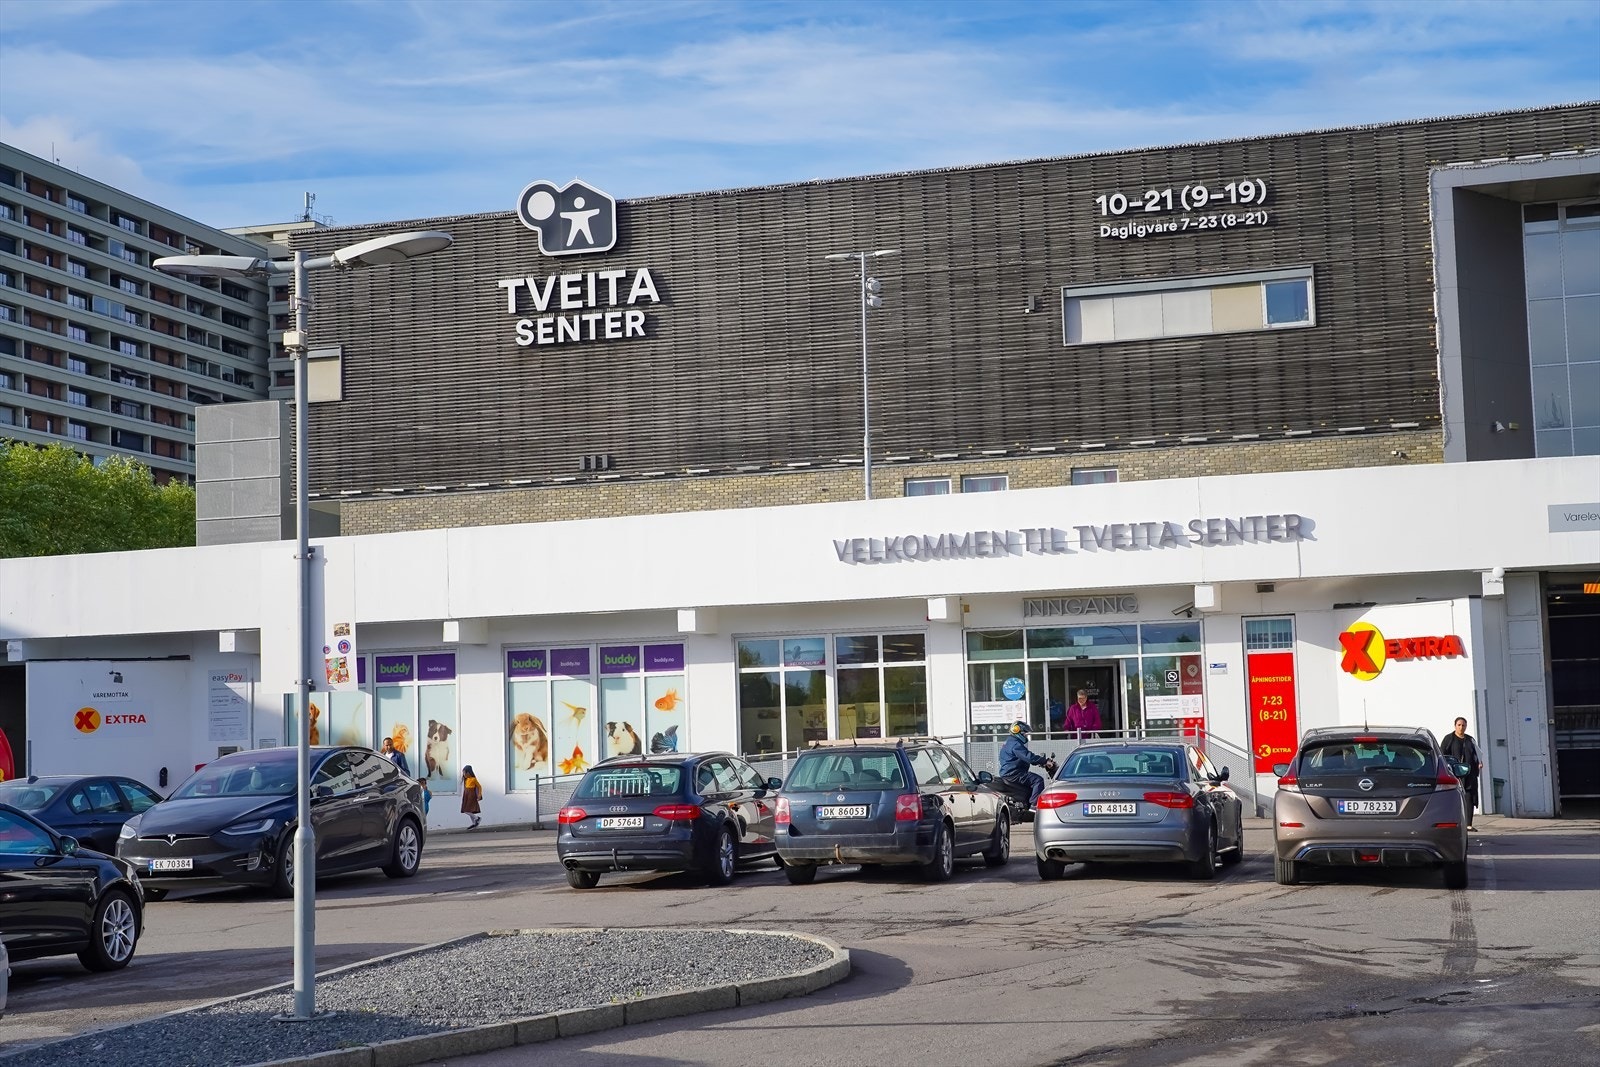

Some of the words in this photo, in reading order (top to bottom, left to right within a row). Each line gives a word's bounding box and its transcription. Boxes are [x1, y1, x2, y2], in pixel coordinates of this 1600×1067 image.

[1095, 188, 1173, 216] 10-21
[1180, 178, 1267, 211] (9-19)
[1100, 221, 1177, 239] Dagligvare
[1180, 215, 1217, 231] 7-23
[1221, 210, 1268, 228] (8-21)
[498, 268, 660, 314] TVEITA
[515, 310, 646, 346] SENTER
[833, 529, 1010, 562] VELKOMMEN
[1020, 526, 1066, 552] TIL
[1073, 520, 1178, 550] TVEITA
[1188, 513, 1304, 545] SENTER
[1023, 593, 1138, 617] INNGANG
[1384, 635, 1465, 660] EXTRA
[512, 658, 543, 670] buddy
[604, 653, 636, 666] buddy
[380, 663, 411, 675] buddy
[212, 673, 243, 682] easyPay
[1262, 696, 1283, 705] 7-23
[105, 714, 147, 724] EXTRA
[1259, 709, 1288, 721] (8-21)
[823, 807, 835, 815] DK
[838, 807, 865, 815] 86053
[1090, 804, 1103, 813] DR
[1106, 804, 1134, 813] 48143
[1347, 802, 1359, 810] ED
[1363, 802, 1394, 810] 78232
[603, 818, 614, 827] DP
[617, 817, 642, 826] 57643
[167, 860, 191, 868] 70384
